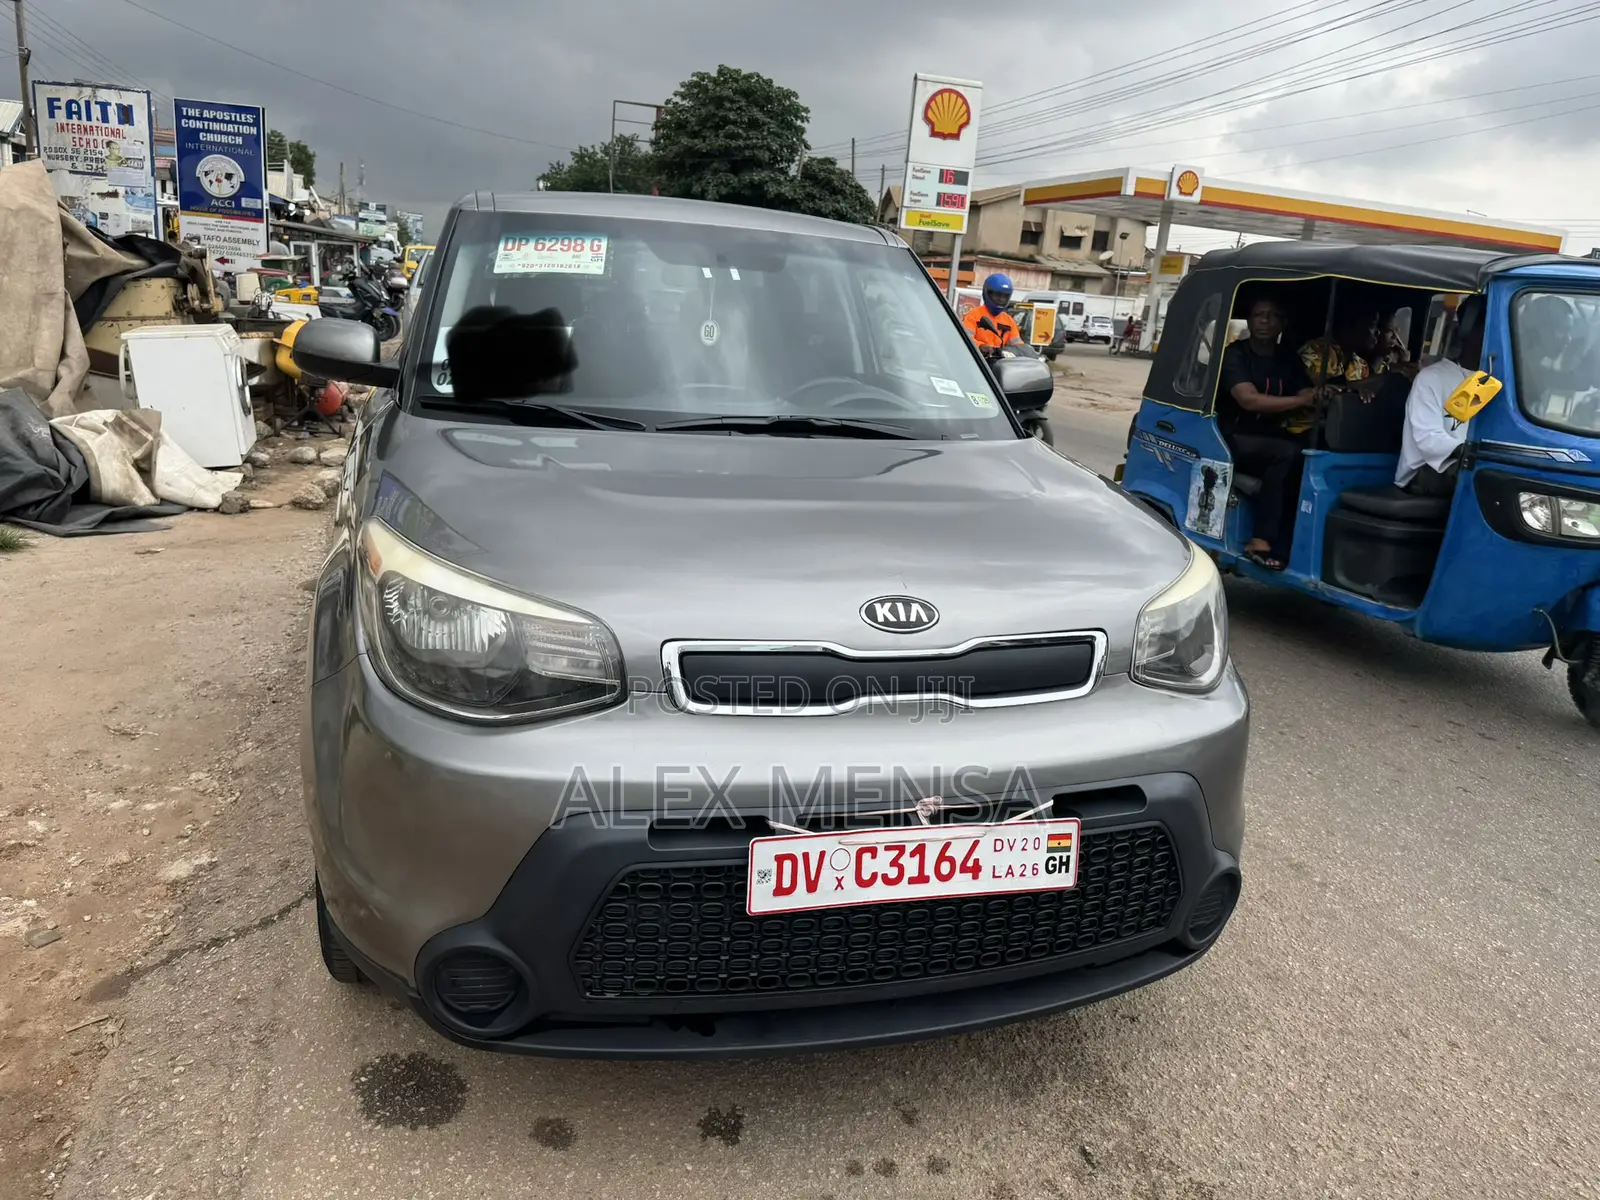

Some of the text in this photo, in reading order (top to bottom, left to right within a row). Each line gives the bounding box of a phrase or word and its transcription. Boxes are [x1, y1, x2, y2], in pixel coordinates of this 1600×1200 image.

[46, 97, 135, 127] FAITH
[181, 106, 256, 124] THE APOSTLES'
[56, 122, 127, 140] INTERNATIONAL
[181, 118, 257, 135] CONTINUATION
[199, 131, 243, 145] CHURCH
[83, 148, 104, 157] 2154
[185, 142, 256, 156] INTERNATIONAL
[70, 162, 78, 170] &
[943, 168, 955, 185] 16
[210, 198, 235, 208] ACCI
[918, 218, 950, 228] FuelSave
[203, 234, 221, 243] TAFO
[222, 236, 261, 247] ASSEMBLY
[502, 236, 602, 253] DP 6298 G
[1158, 440, 1188, 454] DELUXE
[873, 602, 929, 624] KIA
[772, 837, 1041, 898] DV C3164 DV20
[834, 854, 1071, 891] X LA26 GH
